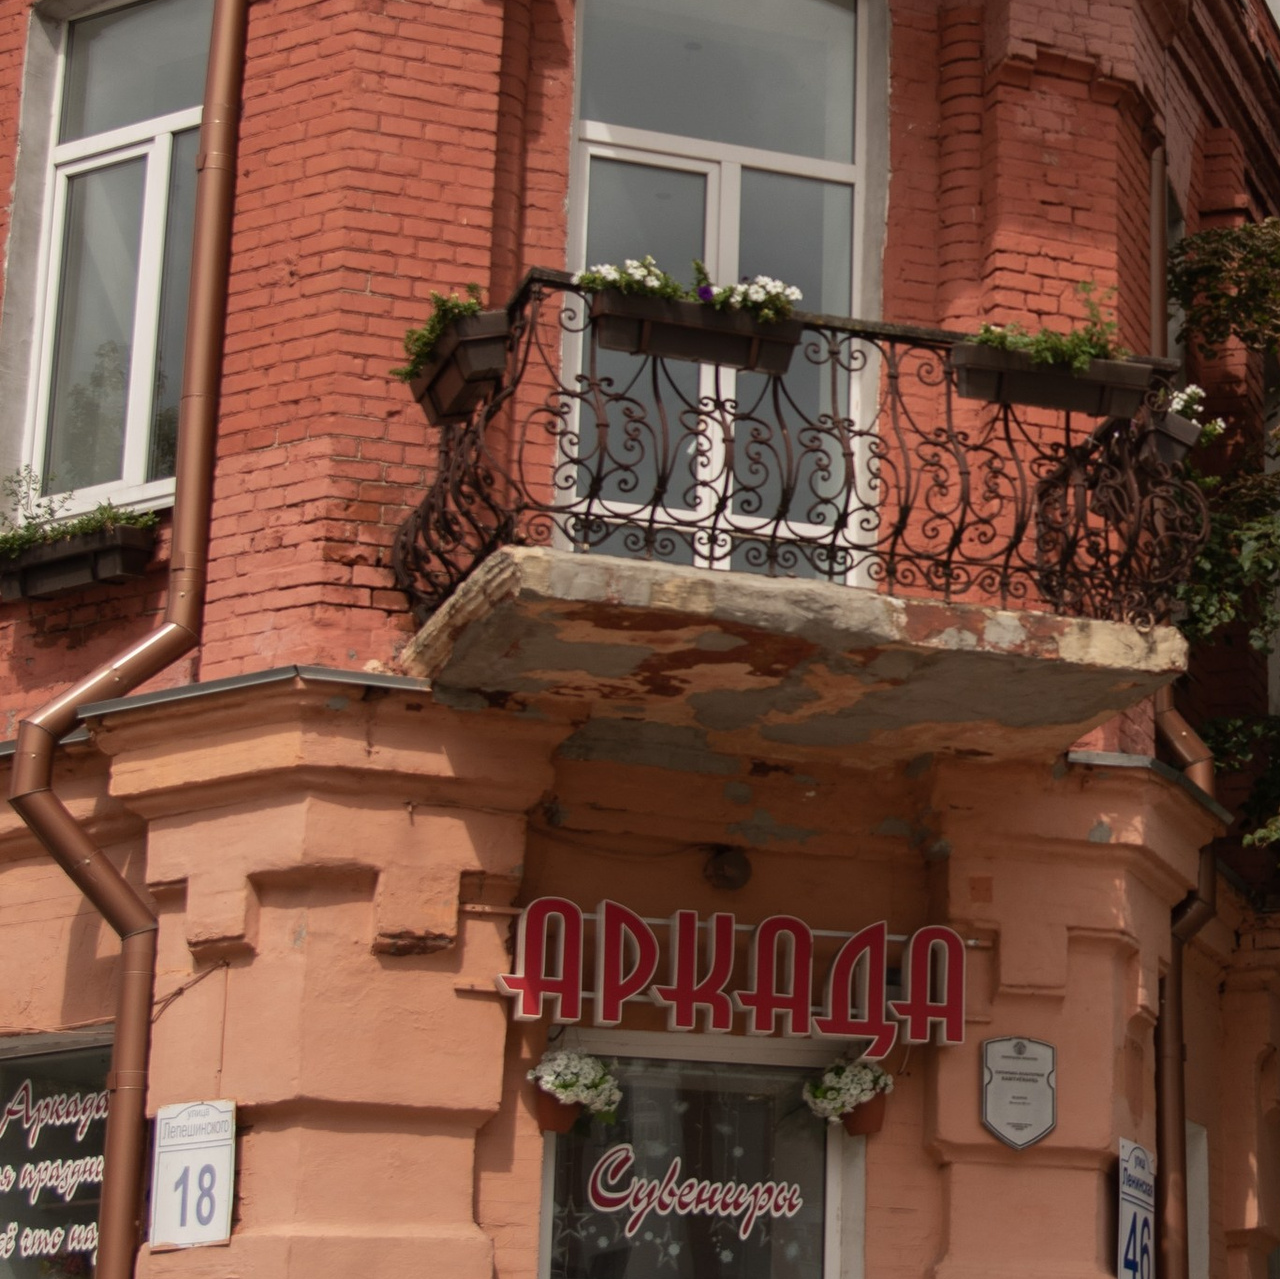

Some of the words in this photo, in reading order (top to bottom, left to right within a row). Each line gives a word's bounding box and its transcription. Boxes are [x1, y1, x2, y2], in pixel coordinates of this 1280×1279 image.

[497, 897, 966, 1060] АРКАДА
[0, 1078, 110, 1148] Аркада
[162, 1118, 230, 1140] Лепешинского
[186, 1108, 210, 1121] улица
[173, 1163, 217, 1227] 18
[587, 1143, 804, 1240] Сувениры
[20, 1224, 65, 1257] что
